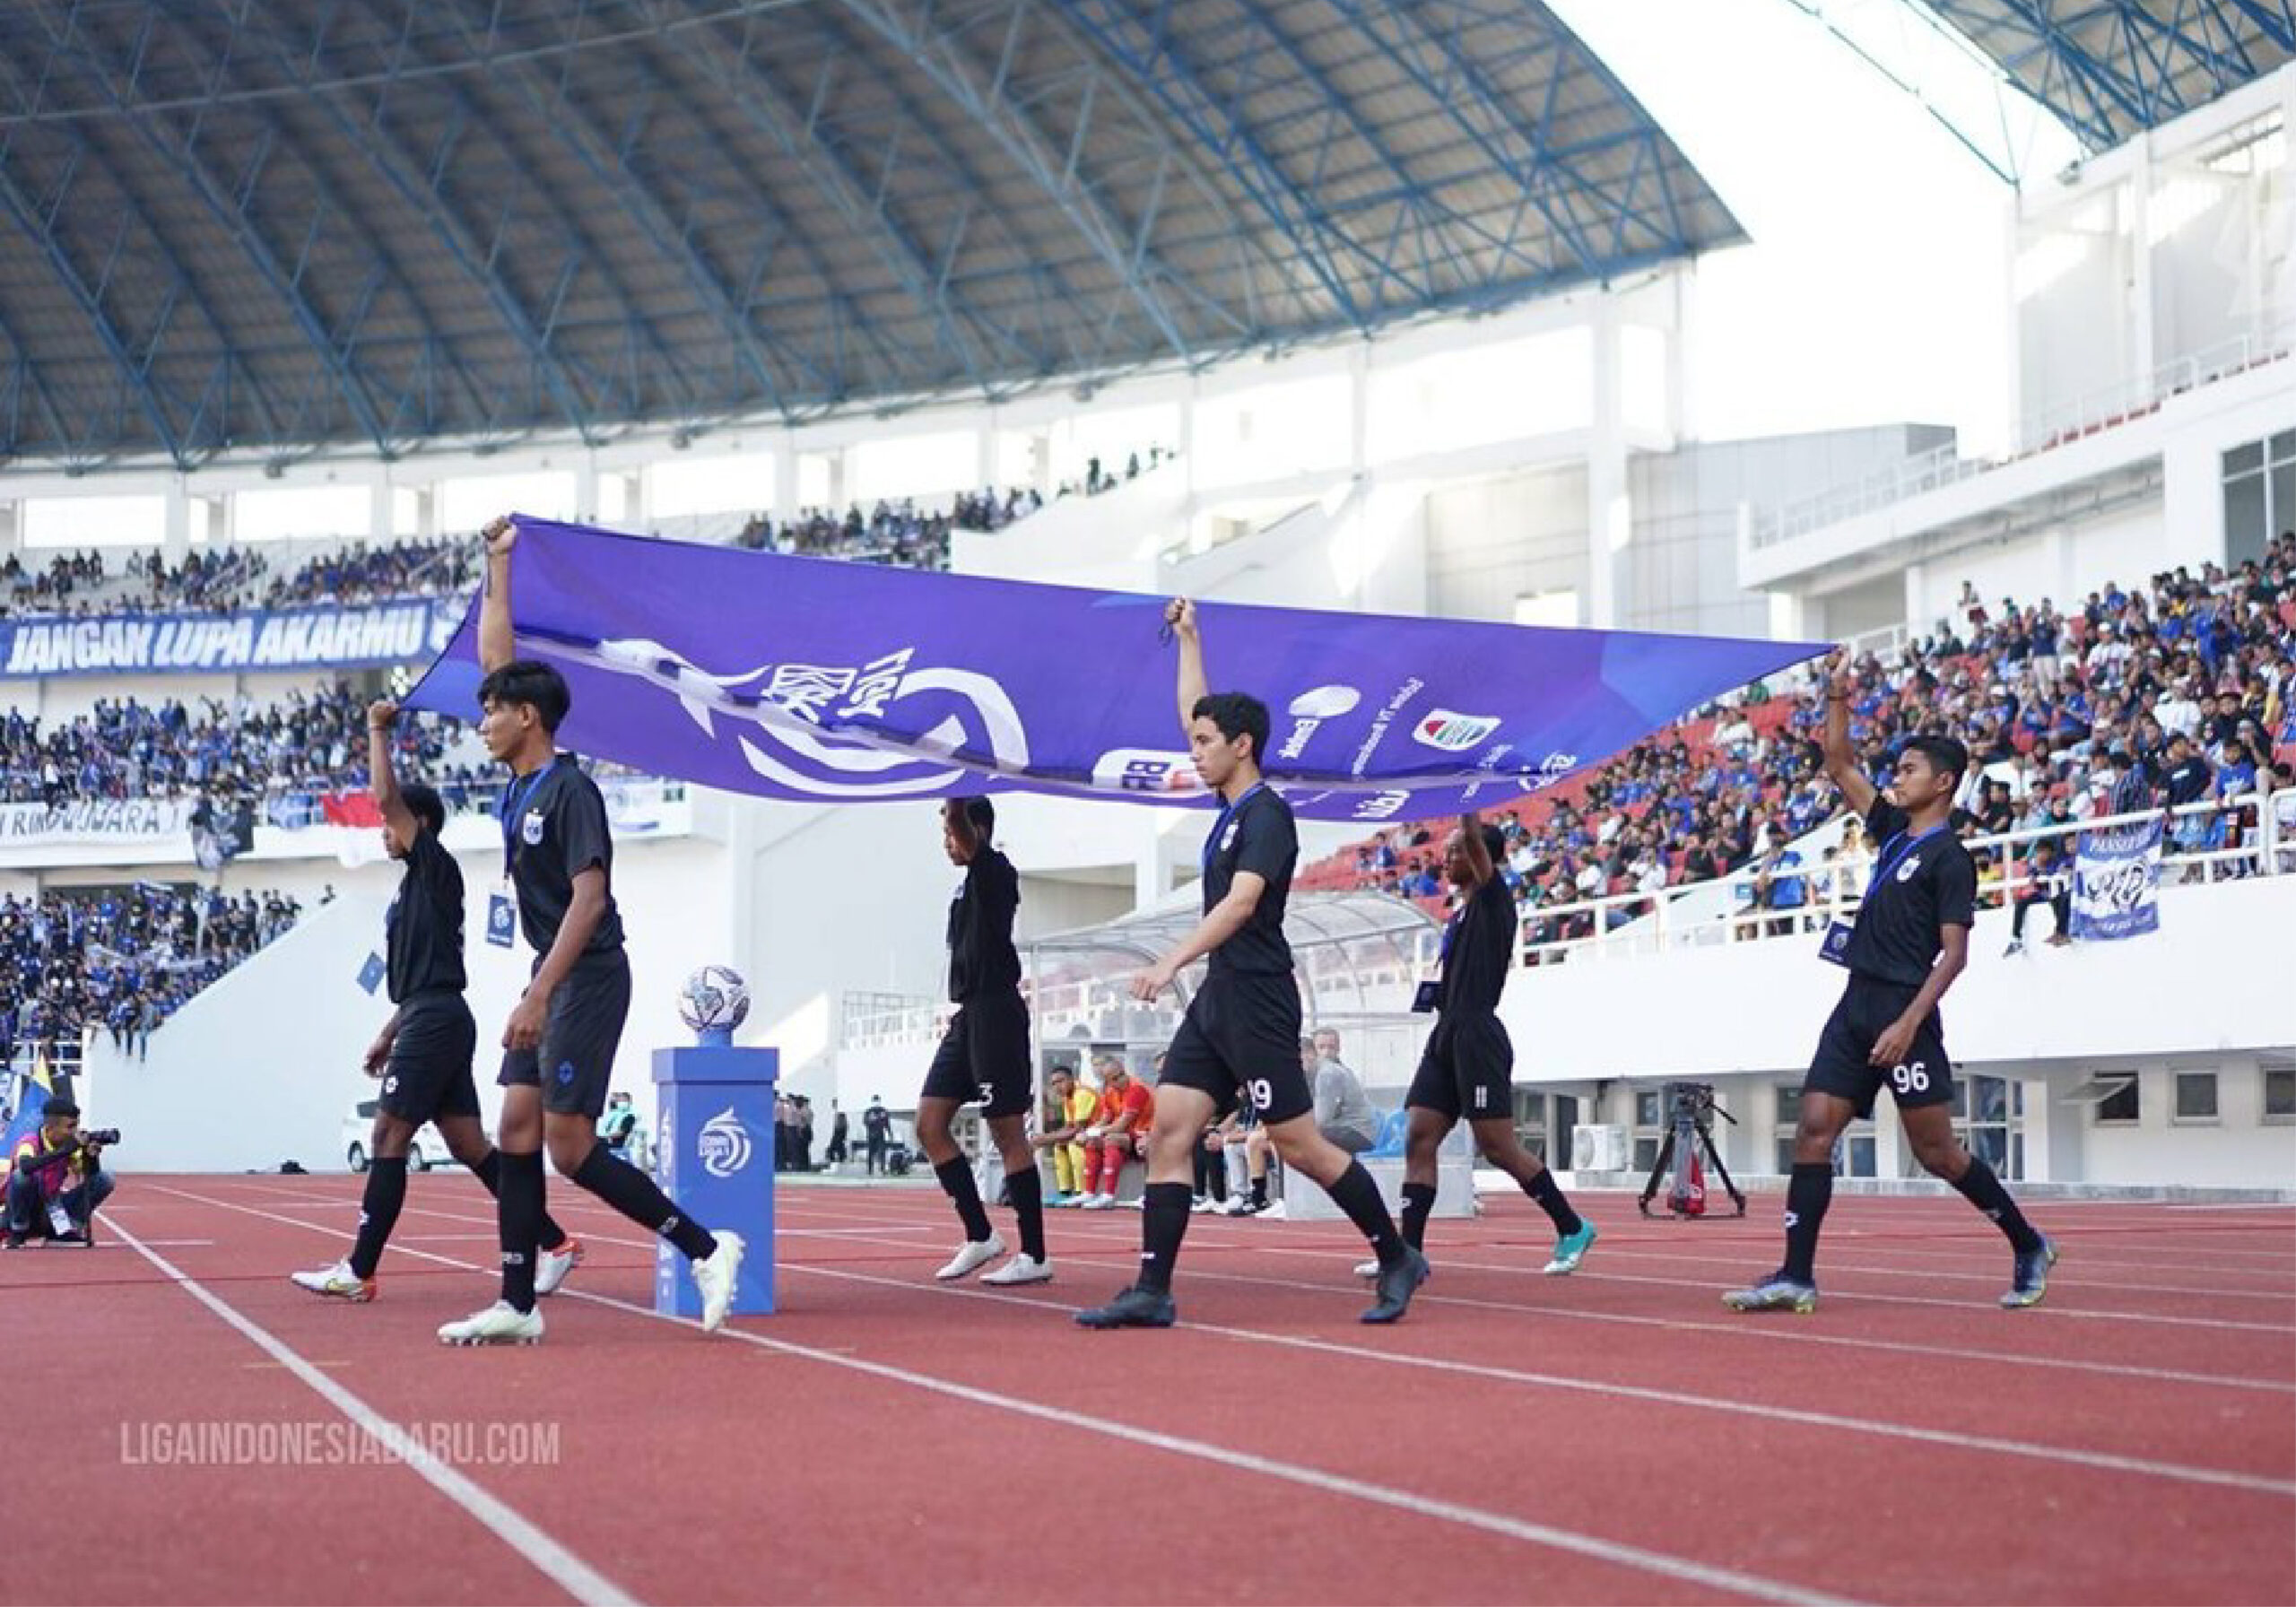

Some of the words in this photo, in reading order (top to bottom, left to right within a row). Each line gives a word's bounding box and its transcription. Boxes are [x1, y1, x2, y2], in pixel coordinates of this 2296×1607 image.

[7, 620, 152, 672] JANGAN
[153, 618, 253, 667] LUPA
[1893, 1062, 1929, 1093] 96
